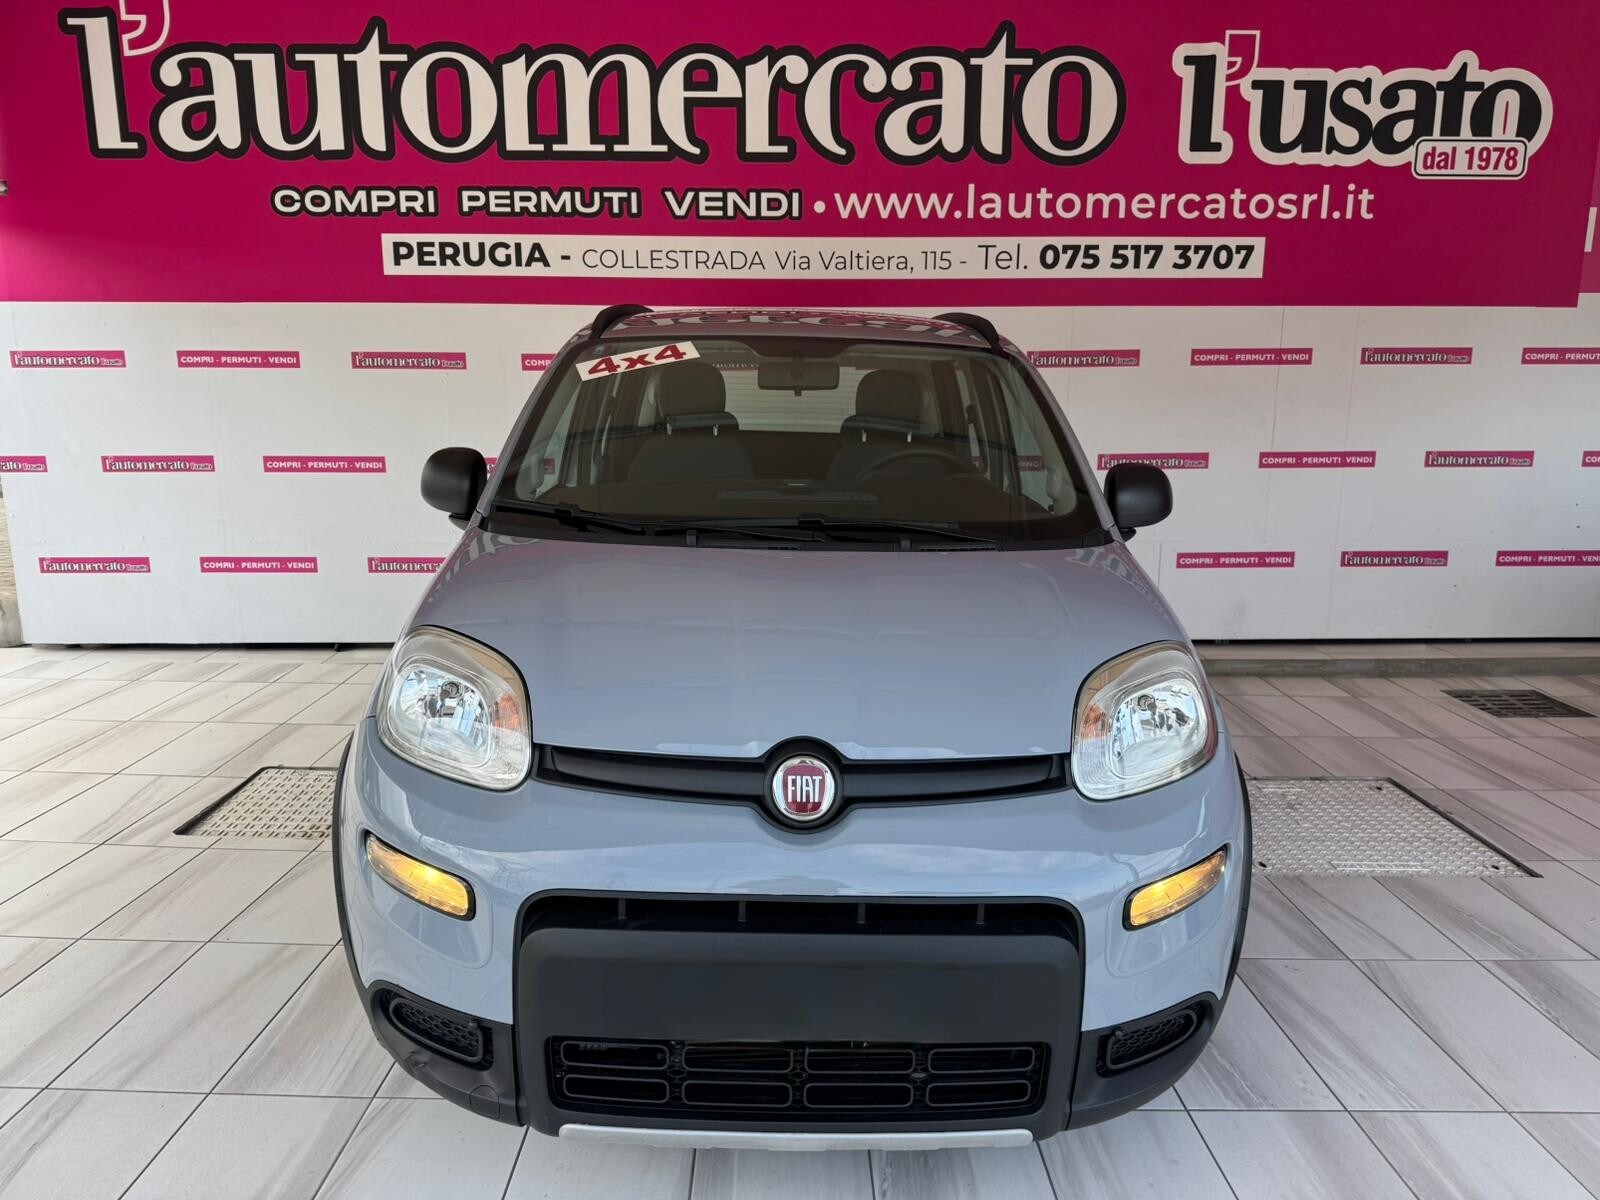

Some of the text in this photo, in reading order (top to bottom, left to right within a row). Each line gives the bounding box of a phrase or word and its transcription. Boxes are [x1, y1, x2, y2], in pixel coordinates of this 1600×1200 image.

[64, 0, 1120, 159] l'automercato
[1421, 146, 1519, 171] dal 1978
[273, 183, 1375, 220] COMPRI PERMUTI VENDI www.lautomercatosrl.it
[392, 241, 551, 267] PERUGIA
[582, 249, 766, 270] COLLESTRADA
[775, 250, 811, 270] Via
[818, 249, 914, 274] Valtiera,
[921, 250, 952, 270] 115
[977, 243, 1028, 271] Tel.
[1039, 244, 1101, 270] 075
[1110, 244, 1164, 270] 517
[1172, 244, 1256, 270] 3707
[180, 356, 214, 364] COMPRI
[221, 356, 262, 364] PERMUTI
[268, 356, 297, 364] VENDI
[524, 359, 551, 367] COMP
[588, 344, 687, 376] 4x4
[1194, 354, 1229, 362] COMPRI
[1281, 353, 1309, 361] VENDI
[266, 461, 301, 469] COMPRI
[308, 461, 347, 469] PERMUTI
[1262, 457, 1296, 465] COMPRI
[787, 775, 822, 803] FIAT
